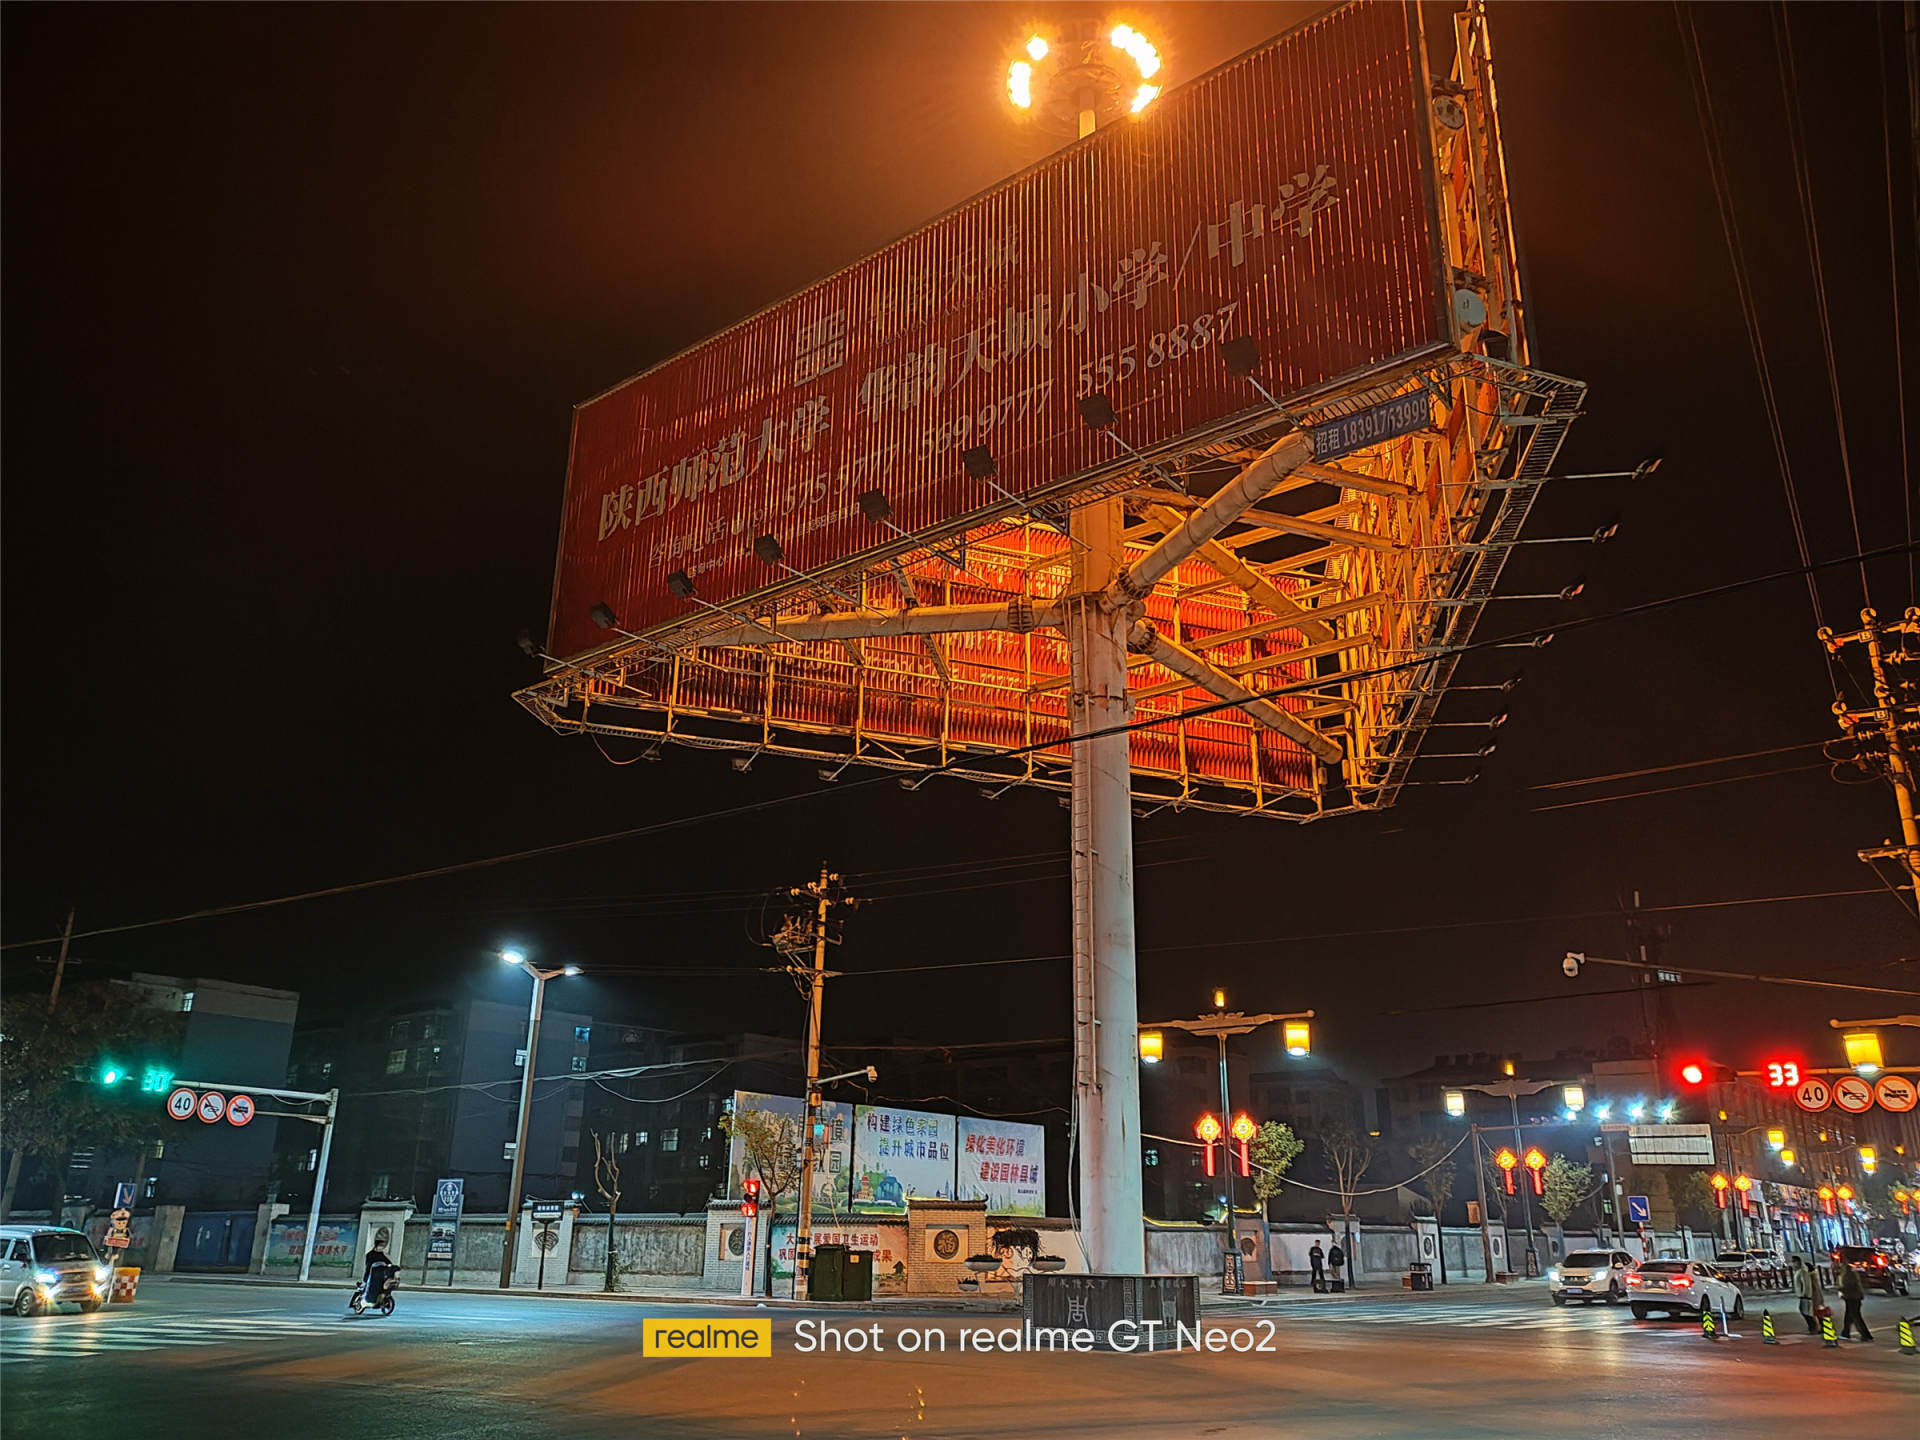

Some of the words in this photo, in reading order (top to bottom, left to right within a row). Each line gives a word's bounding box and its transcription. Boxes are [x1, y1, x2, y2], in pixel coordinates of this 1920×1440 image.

[979, 378, 1055, 438] 9777
[1076, 345, 1137, 398] 555
[1146, 302, 1239, 368] 8887
[1316, 428, 1340, 455] 招租
[598, 395, 831, 542] 陕西师范大学
[1768, 1063, 1799, 1087] 33
[174, 1096, 191, 1111] 40
[1802, 1087, 1824, 1102] 40
[867, 1112, 938, 1137] 构建绿色家园
[879, 1136, 949, 1160] 提升城市品位
[965, 1133, 1025, 1157] 绿化美化环境
[786, 1232, 879, 1246] 大展爱国卫生运动
